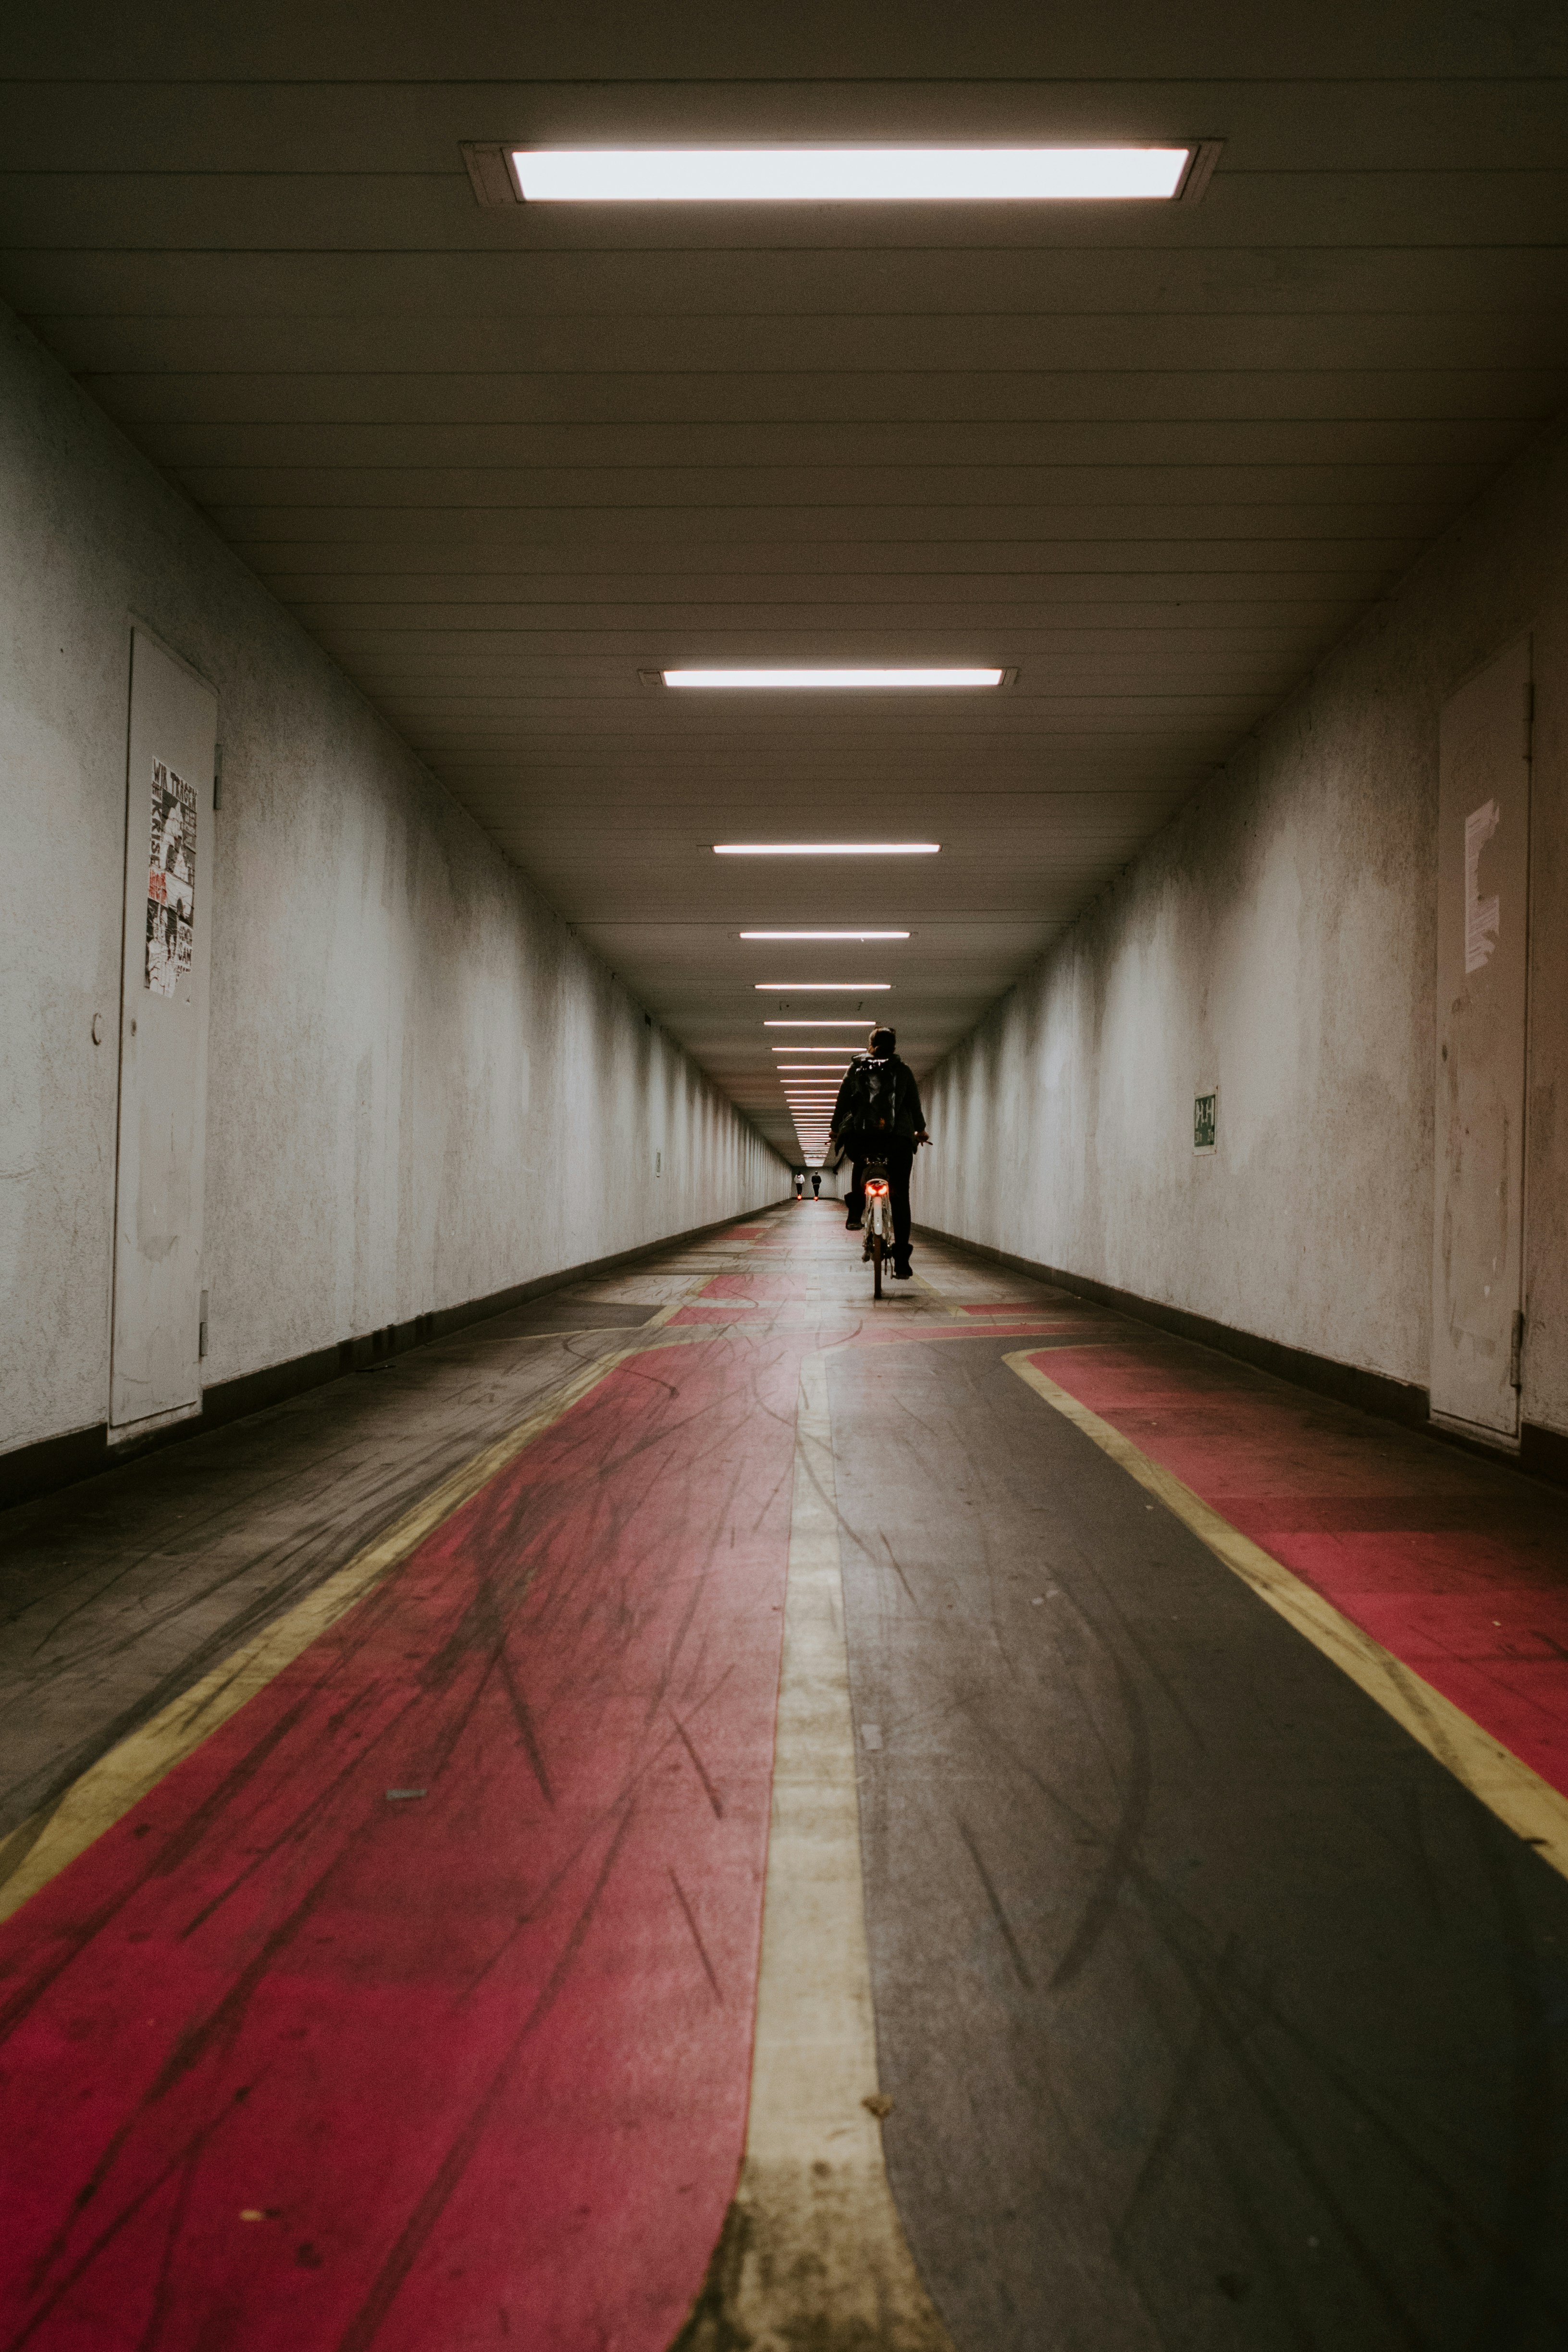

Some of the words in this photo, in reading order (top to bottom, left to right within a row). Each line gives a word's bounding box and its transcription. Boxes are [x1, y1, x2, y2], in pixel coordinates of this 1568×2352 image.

[153, 758, 168, 791] WIR
[171, 771, 197, 813] TRAGEN
[151, 799, 162, 868] KRISE
